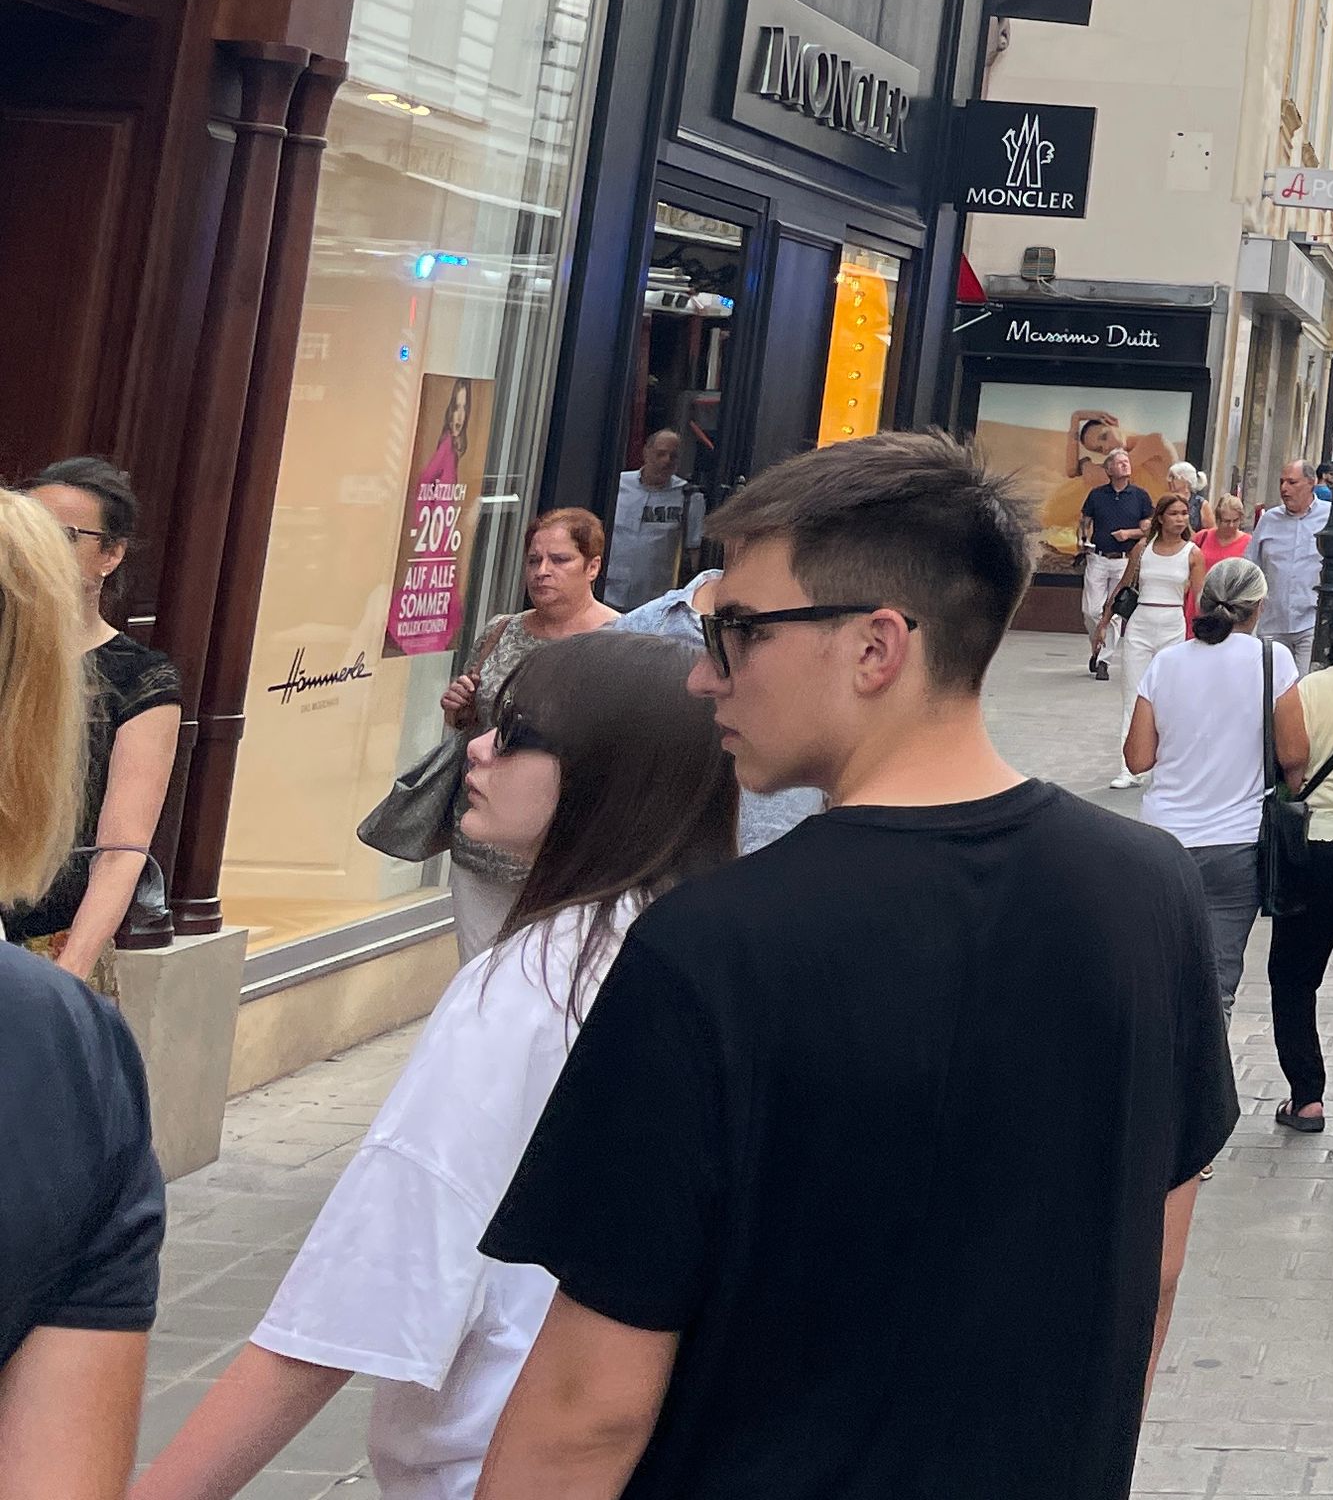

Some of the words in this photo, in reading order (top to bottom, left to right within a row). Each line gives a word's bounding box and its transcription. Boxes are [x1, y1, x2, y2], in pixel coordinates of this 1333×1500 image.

[758, 25, 911, 154] MONCLER
[966, 187, 1075, 210] MONCLER
[1005, 320, 1100, 345] Massimo
[1105, 325, 1161, 348] Dutti
[410, 505, 462, 553] -20%
[403, 566, 428, 591] AUF
[429, 564, 457, 589] ALLE
[399, 591, 450, 619] SOMMER
